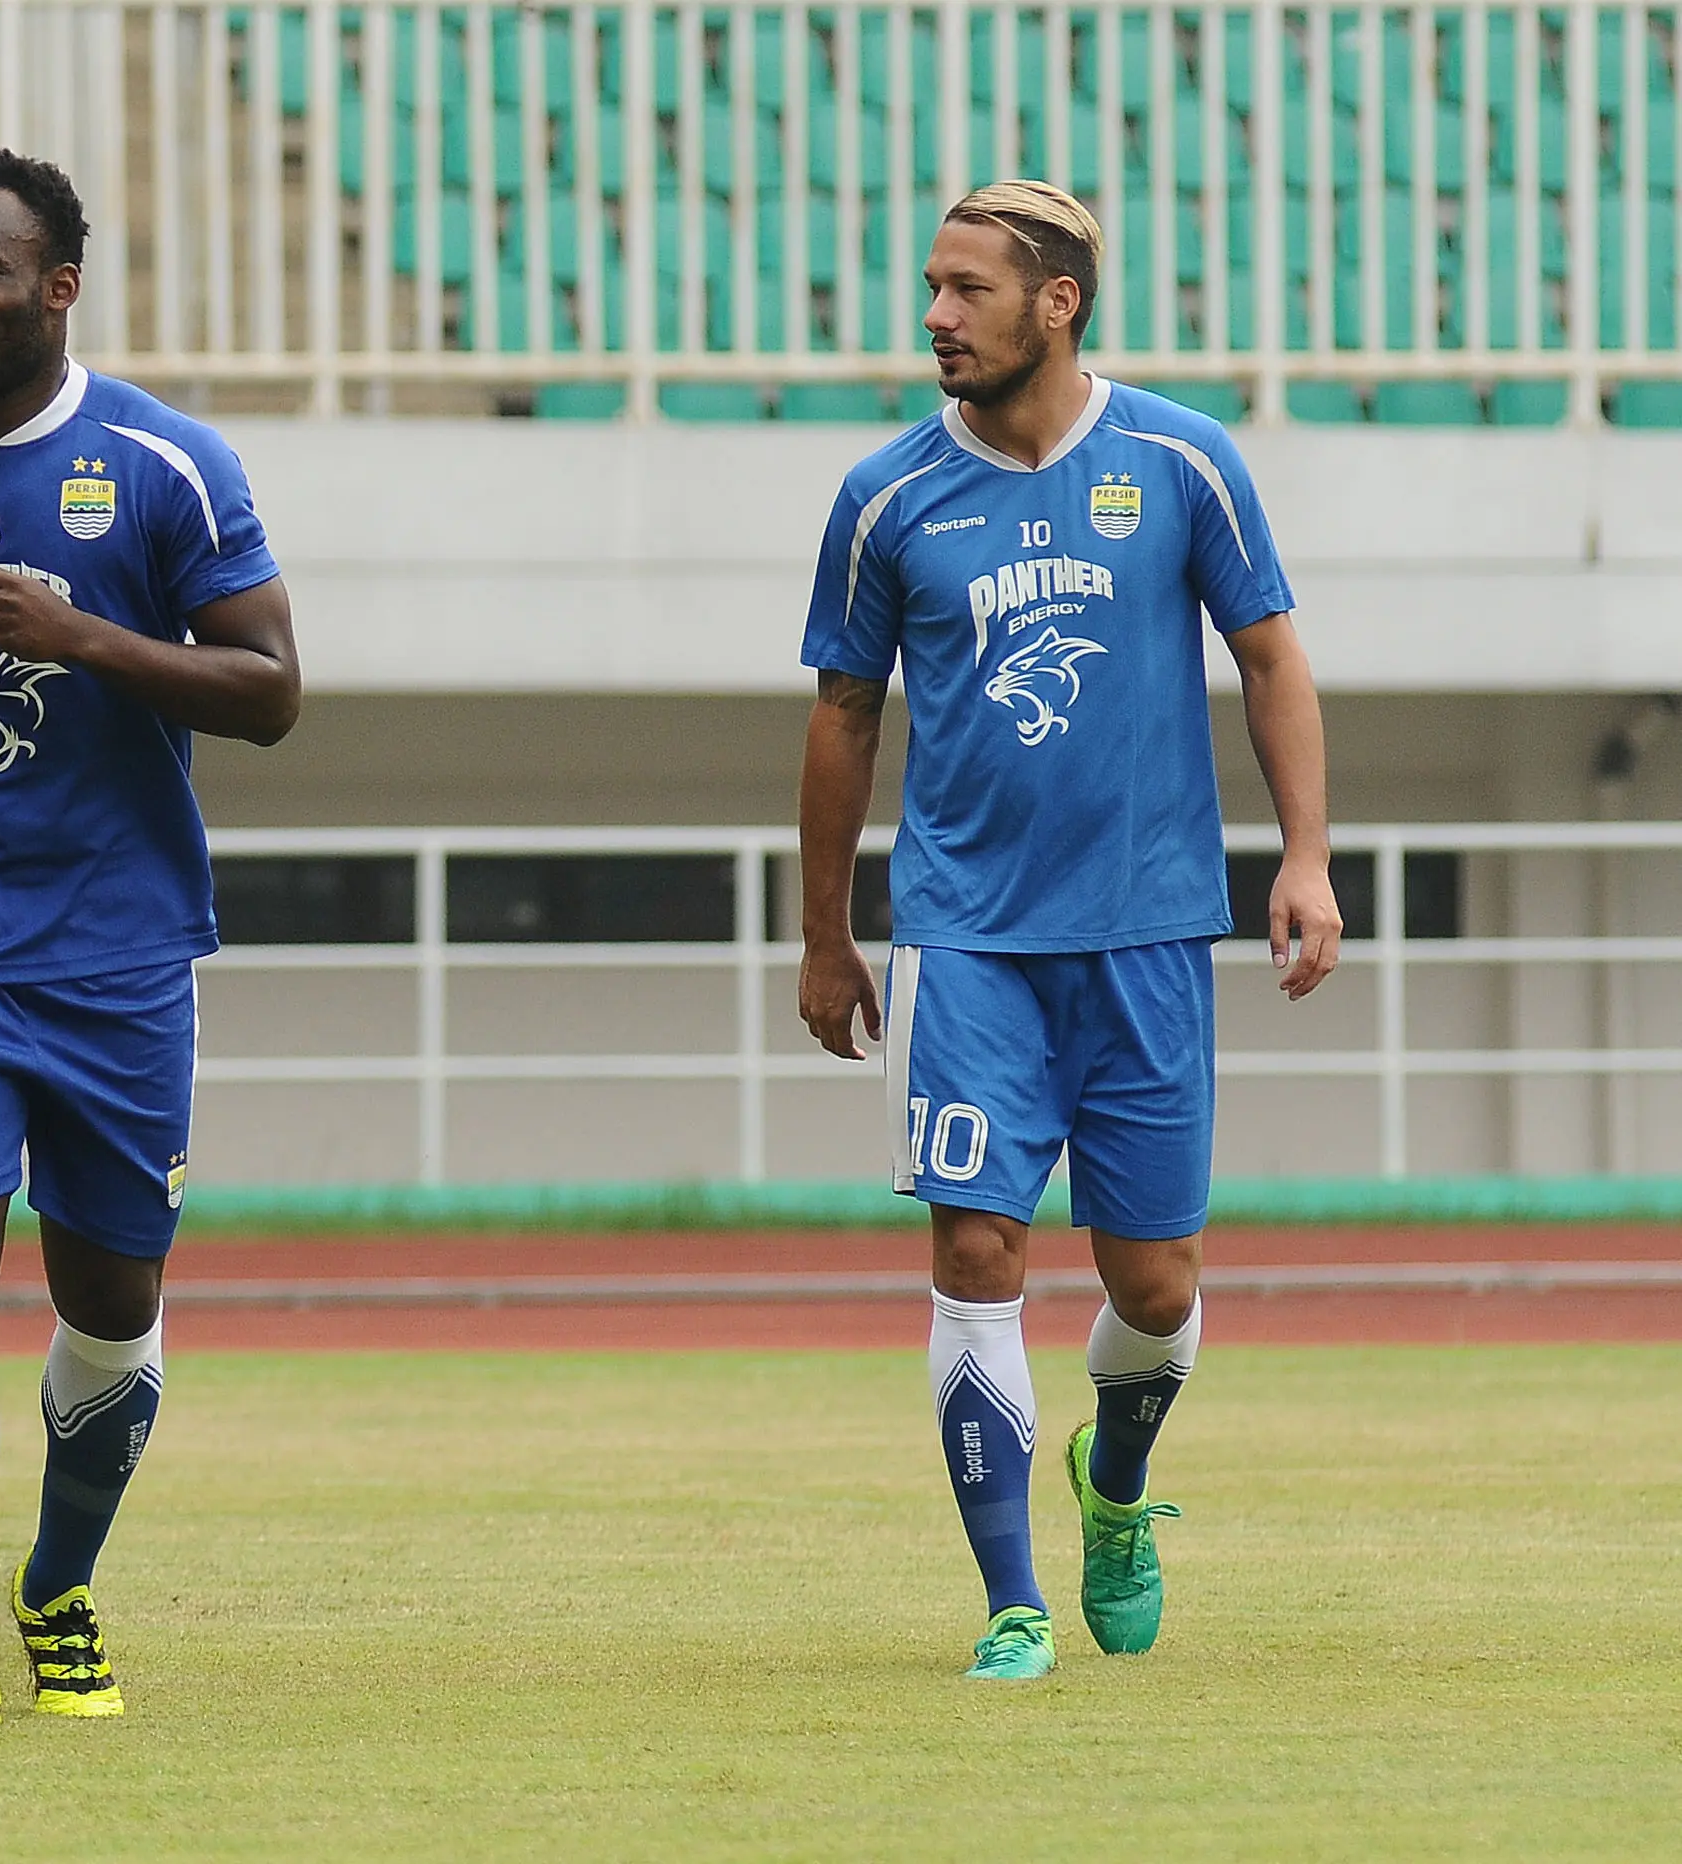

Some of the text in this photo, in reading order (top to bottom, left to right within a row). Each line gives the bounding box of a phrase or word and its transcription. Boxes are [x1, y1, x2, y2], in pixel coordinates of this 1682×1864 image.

[921, 513, 987, 537] Sportama
[1019, 519, 1053, 548] 10
[968, 552, 1116, 669] PANTHER
[1007, 602, 1086, 637] ENERGY
[910, 1096, 990, 1182] 10
[963, 1420, 993, 1486] Sportama
